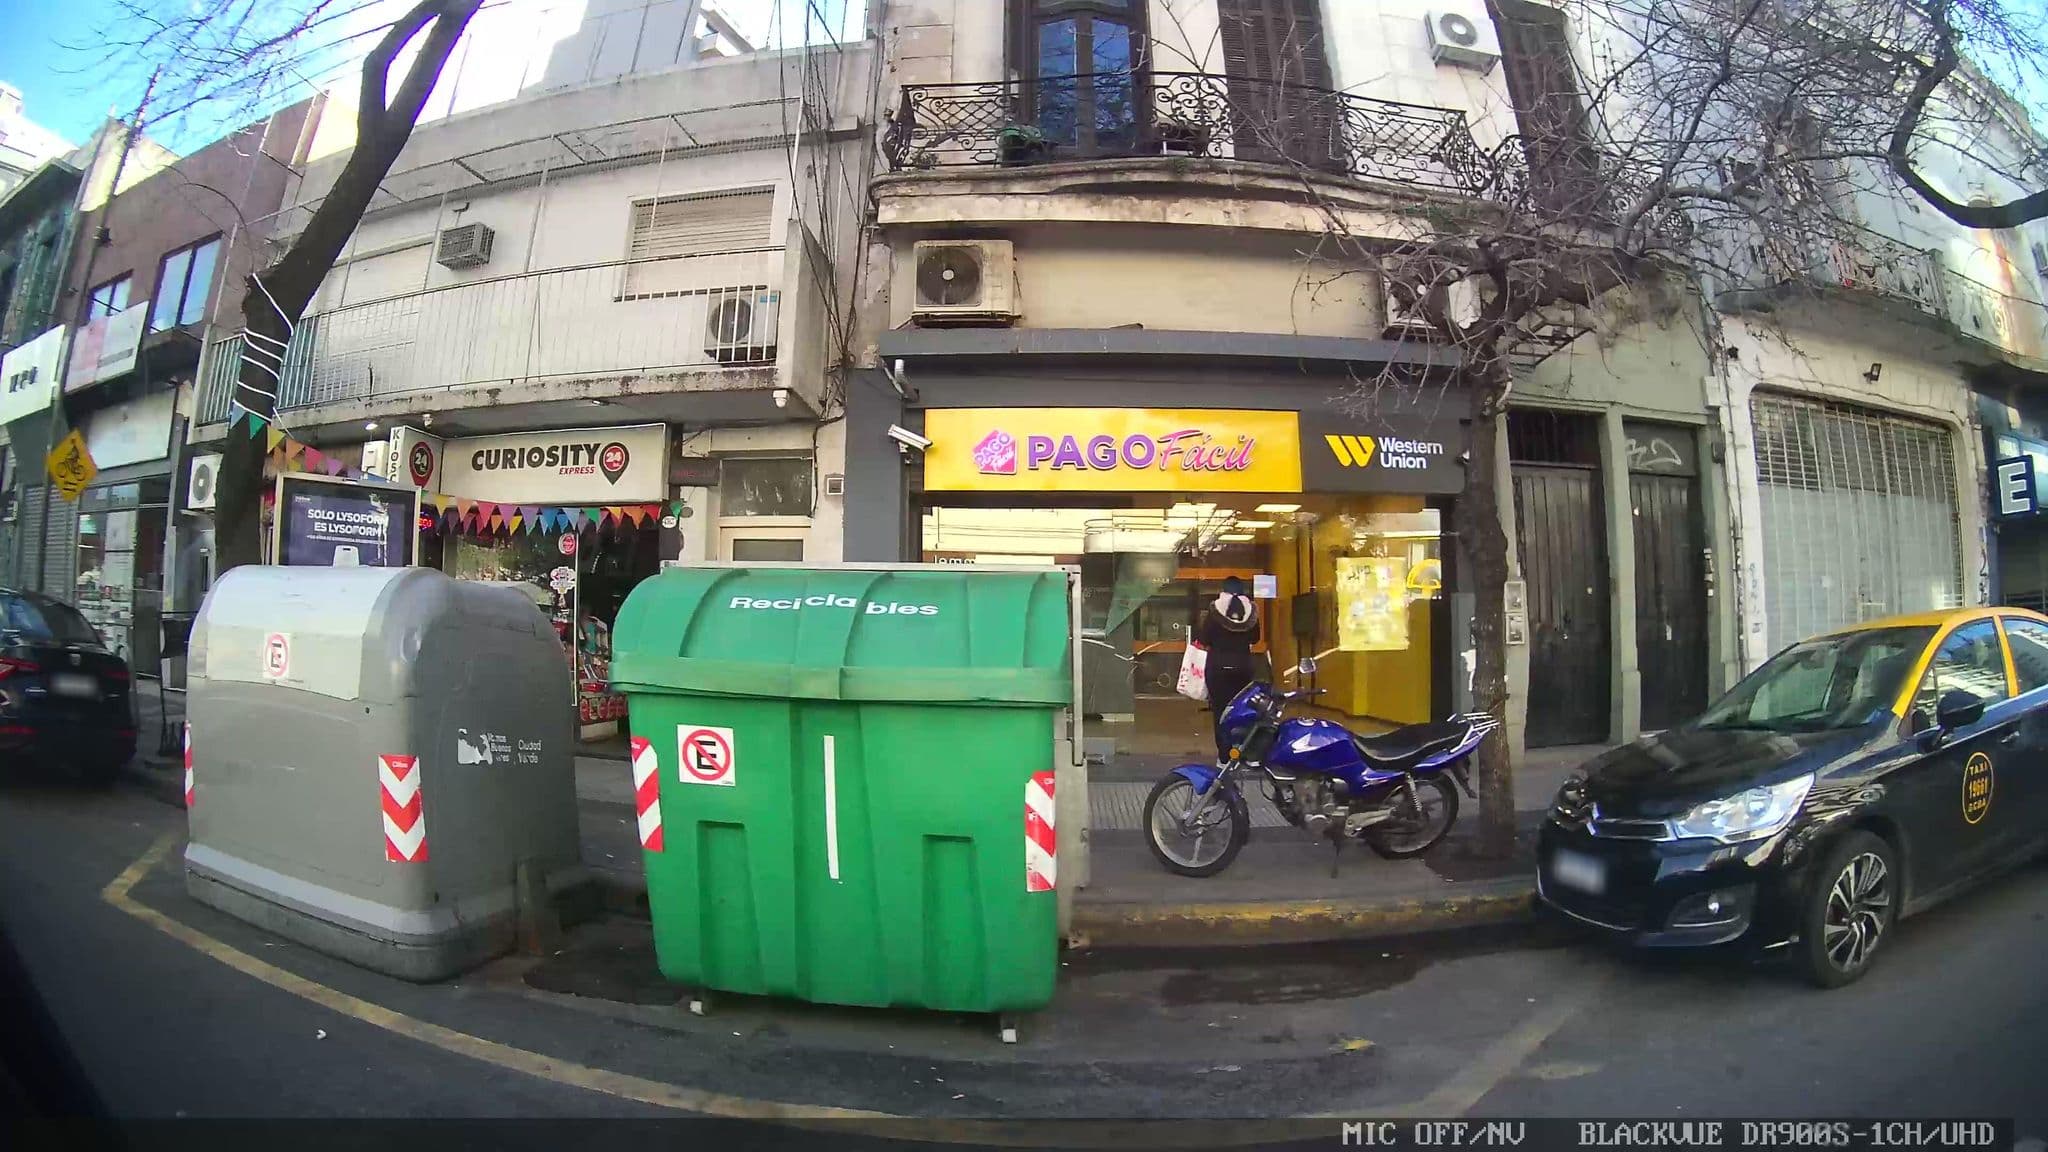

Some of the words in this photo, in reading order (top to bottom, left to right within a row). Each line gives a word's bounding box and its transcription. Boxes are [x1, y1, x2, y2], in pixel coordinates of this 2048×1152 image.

[1027, 433, 1156, 471] PAGO
[1158, 429, 1256, 471] Fácil
[1378, 436, 1444, 455] Western
[471, 443, 601, 471] CURIOSITY
[605, 451, 622, 463] 24
[1380, 452, 1428, 469] Union
[559, 465, 596, 475] EXPRESS
[1998, 461, 2031, 514] E
[307, 508, 335, 521] SOLO
[314, 522, 327, 532] ES
[1969, 760, 1988, 776] TAXI
